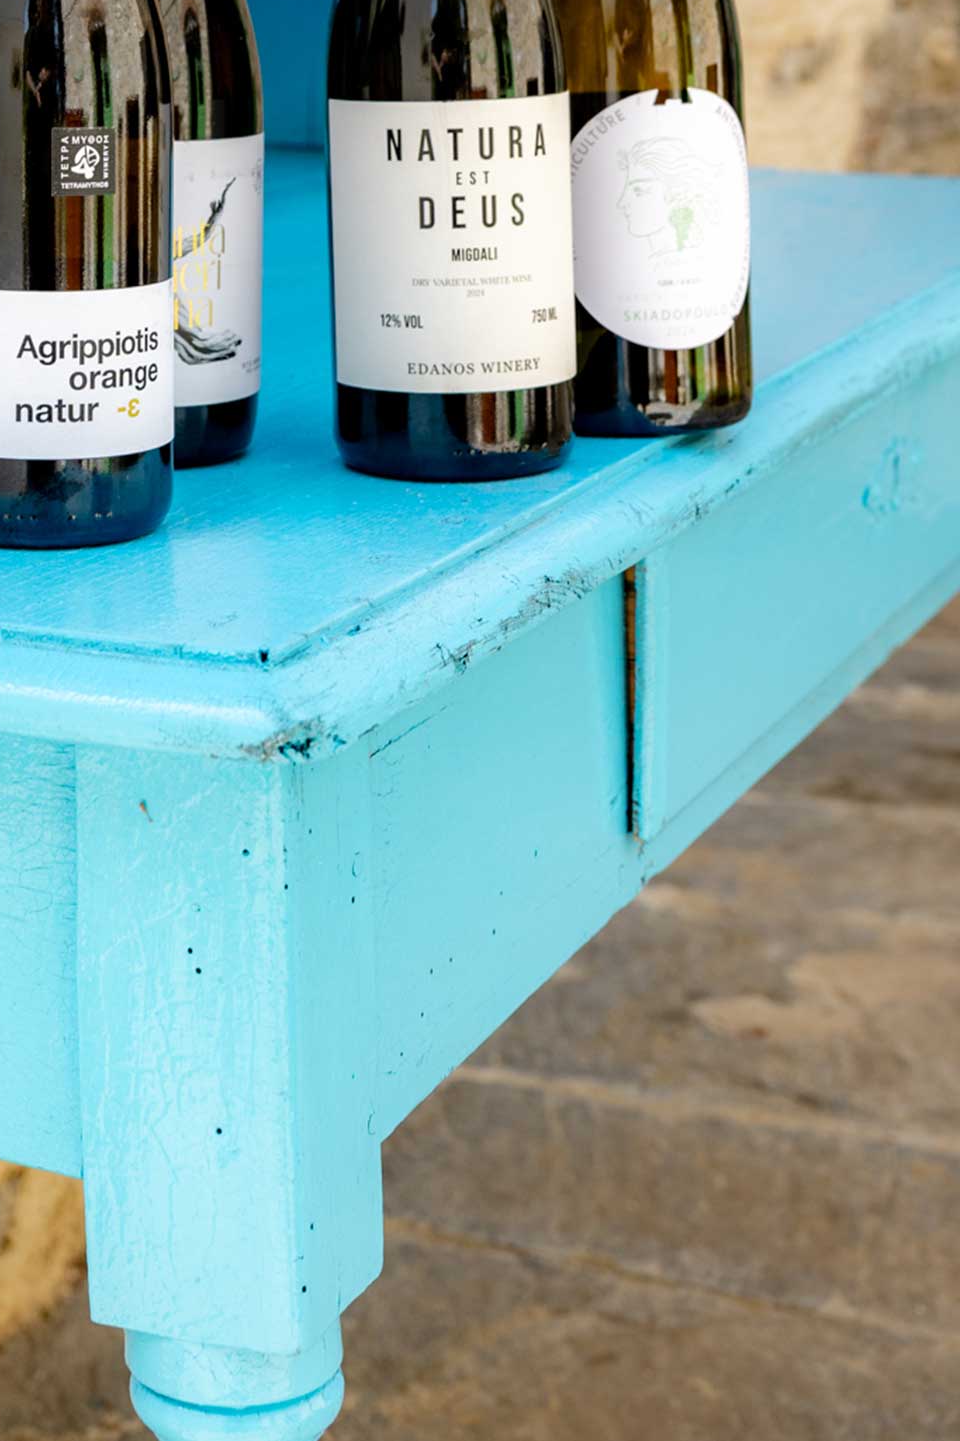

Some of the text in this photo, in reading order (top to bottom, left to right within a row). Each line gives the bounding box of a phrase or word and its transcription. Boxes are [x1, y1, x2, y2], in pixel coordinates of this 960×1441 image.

[386, 123, 547, 162] NATURA
[571, 108, 627, 184] ICULTURE
[455, 171, 491, 186] EST
[418, 192, 526, 230] DEUS
[451, 247, 498, 262] MIGDALI
[380, 313, 424, 329] 12% VOL
[531, 308, 547, 323] 750
[16, 328, 158, 365] Agrippiotis
[70, 363, 158, 391] orange
[407, 358, 541, 375] EDANOS WINERY
[15, 398, 99, 423] natur
